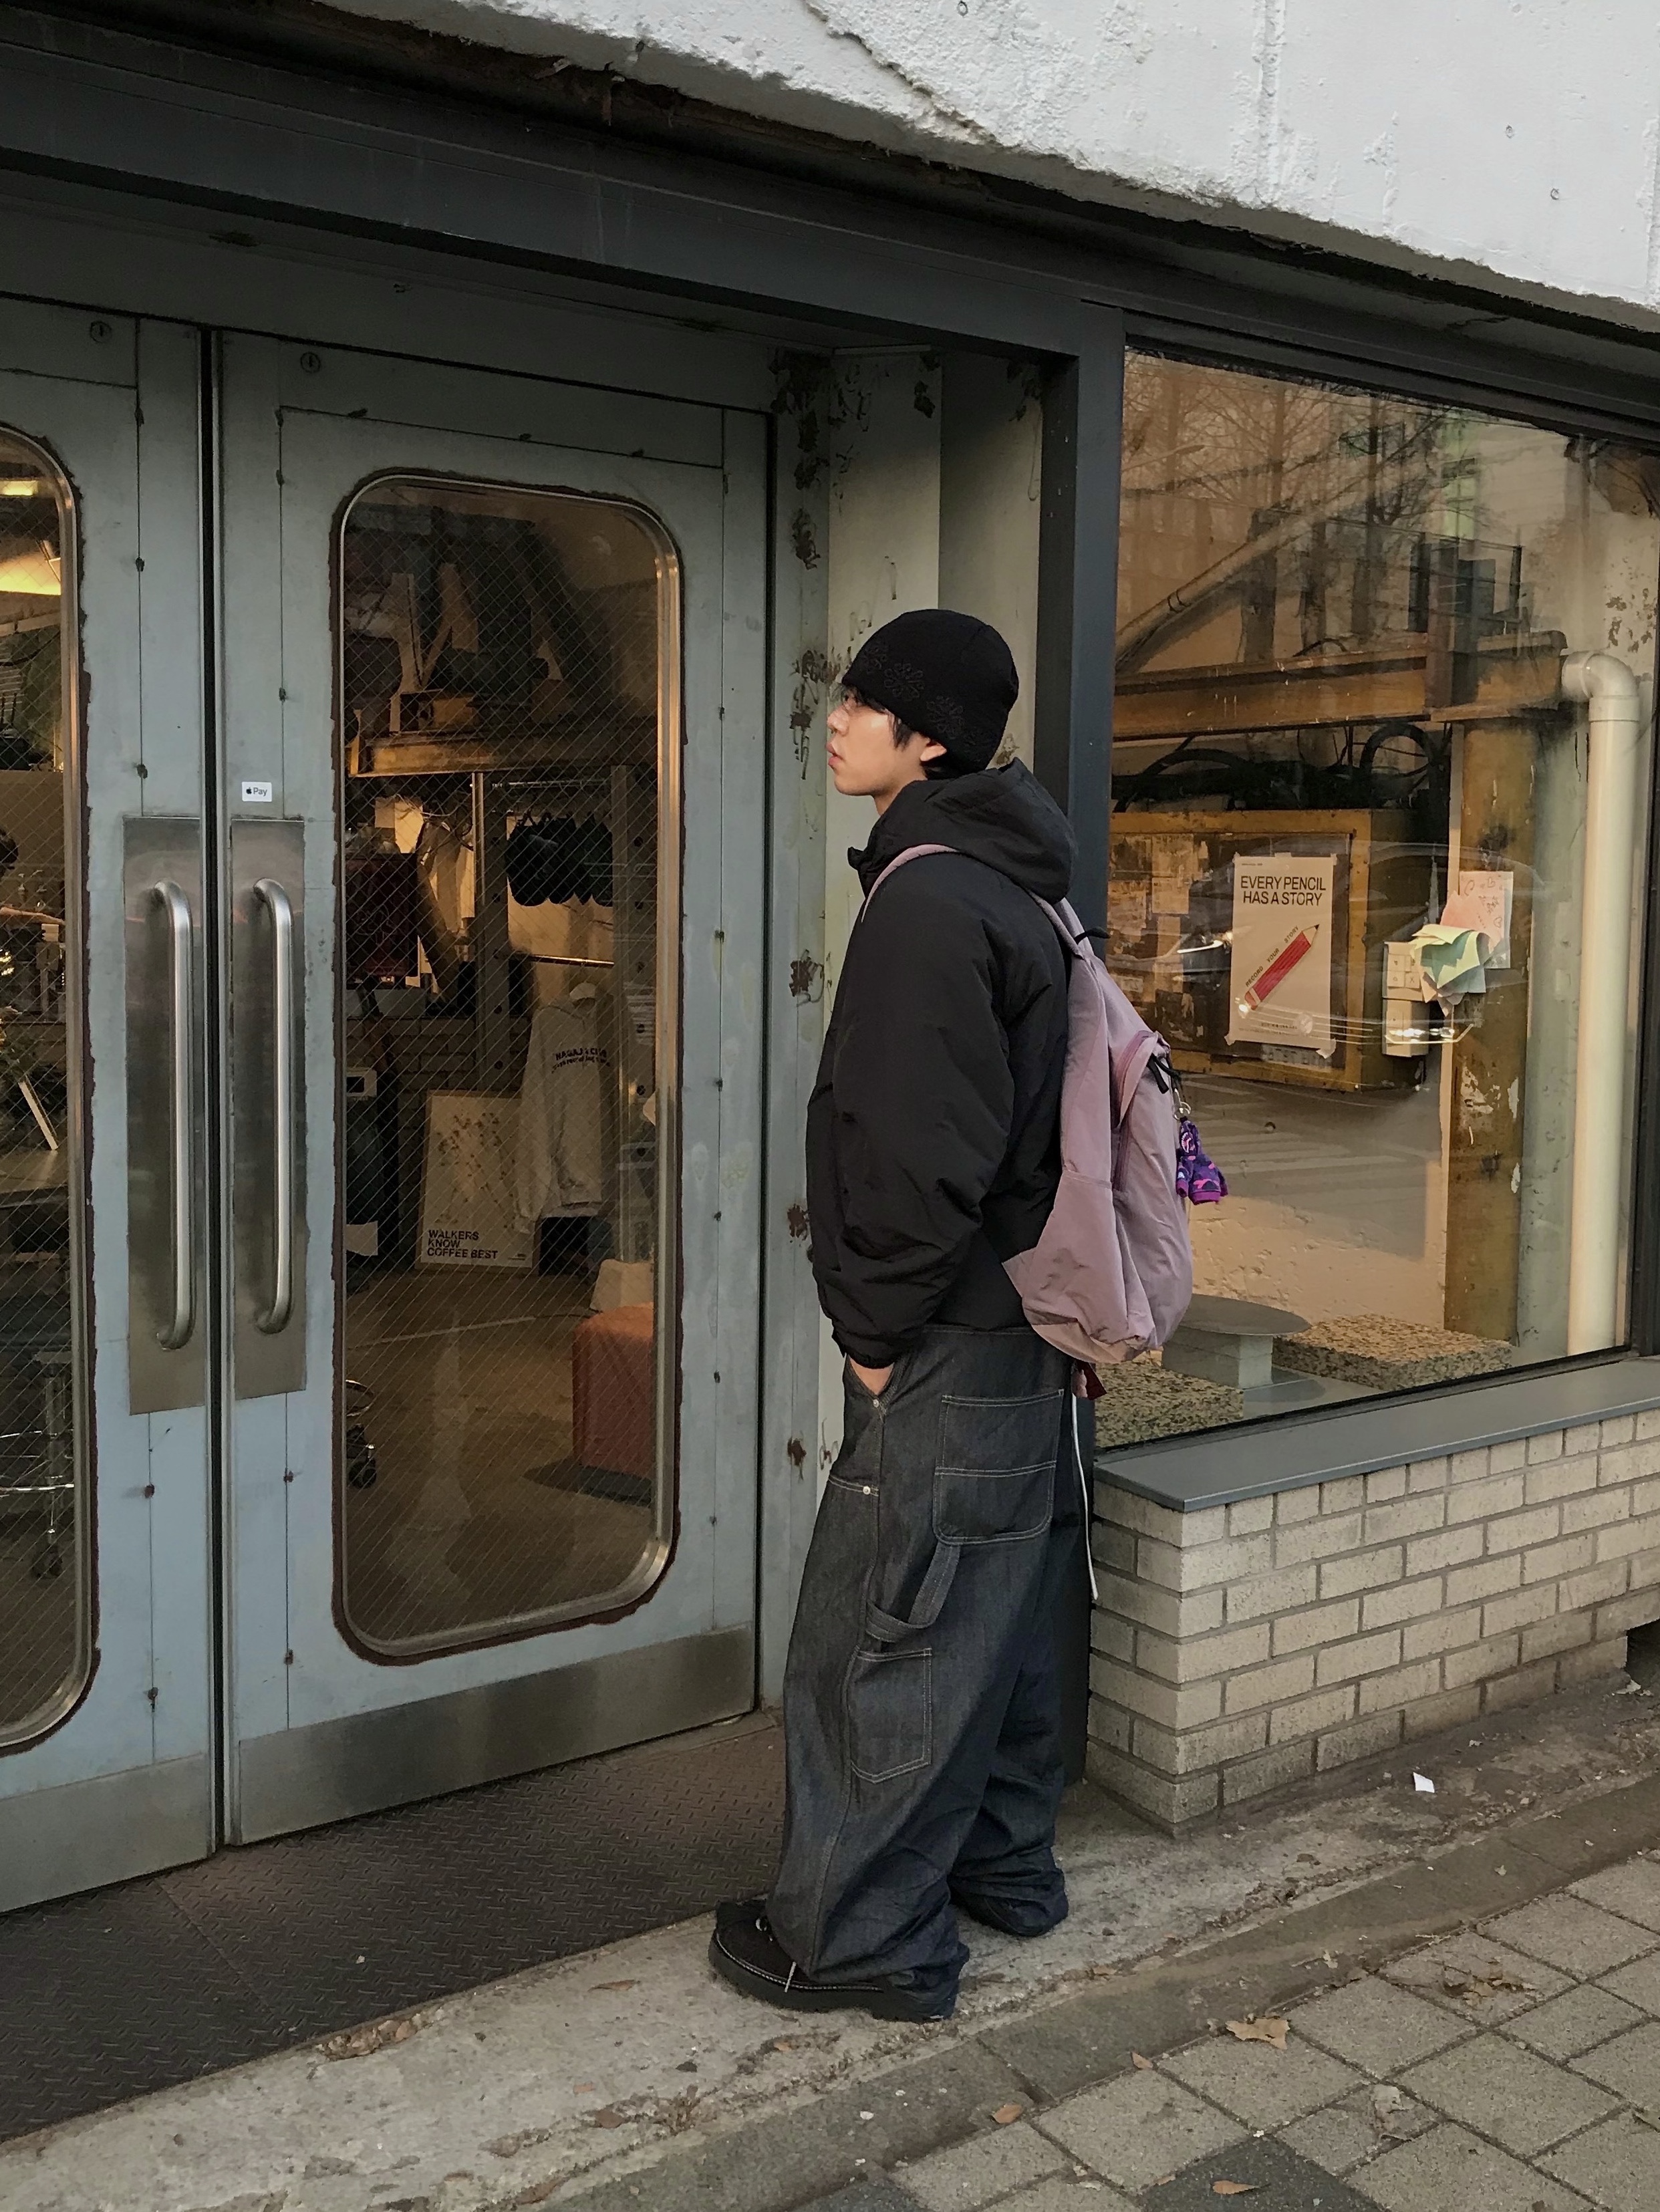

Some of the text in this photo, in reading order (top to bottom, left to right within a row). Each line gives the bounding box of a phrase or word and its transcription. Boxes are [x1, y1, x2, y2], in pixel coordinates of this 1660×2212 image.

[253, 787, 267, 797] Pay
[1240, 875, 1326, 891] EVERY PENCIL
[1243, 891, 1322, 906] HAS A STORY
[1245, 925, 1298, 987] RECORD YOUR STORY
[428, 1230, 479, 1240] WALKERS
[428, 1238, 460, 1248] KNOW
[427, 1248, 468, 1258] COFFEE
[470, 1249, 499, 1258] BEST
